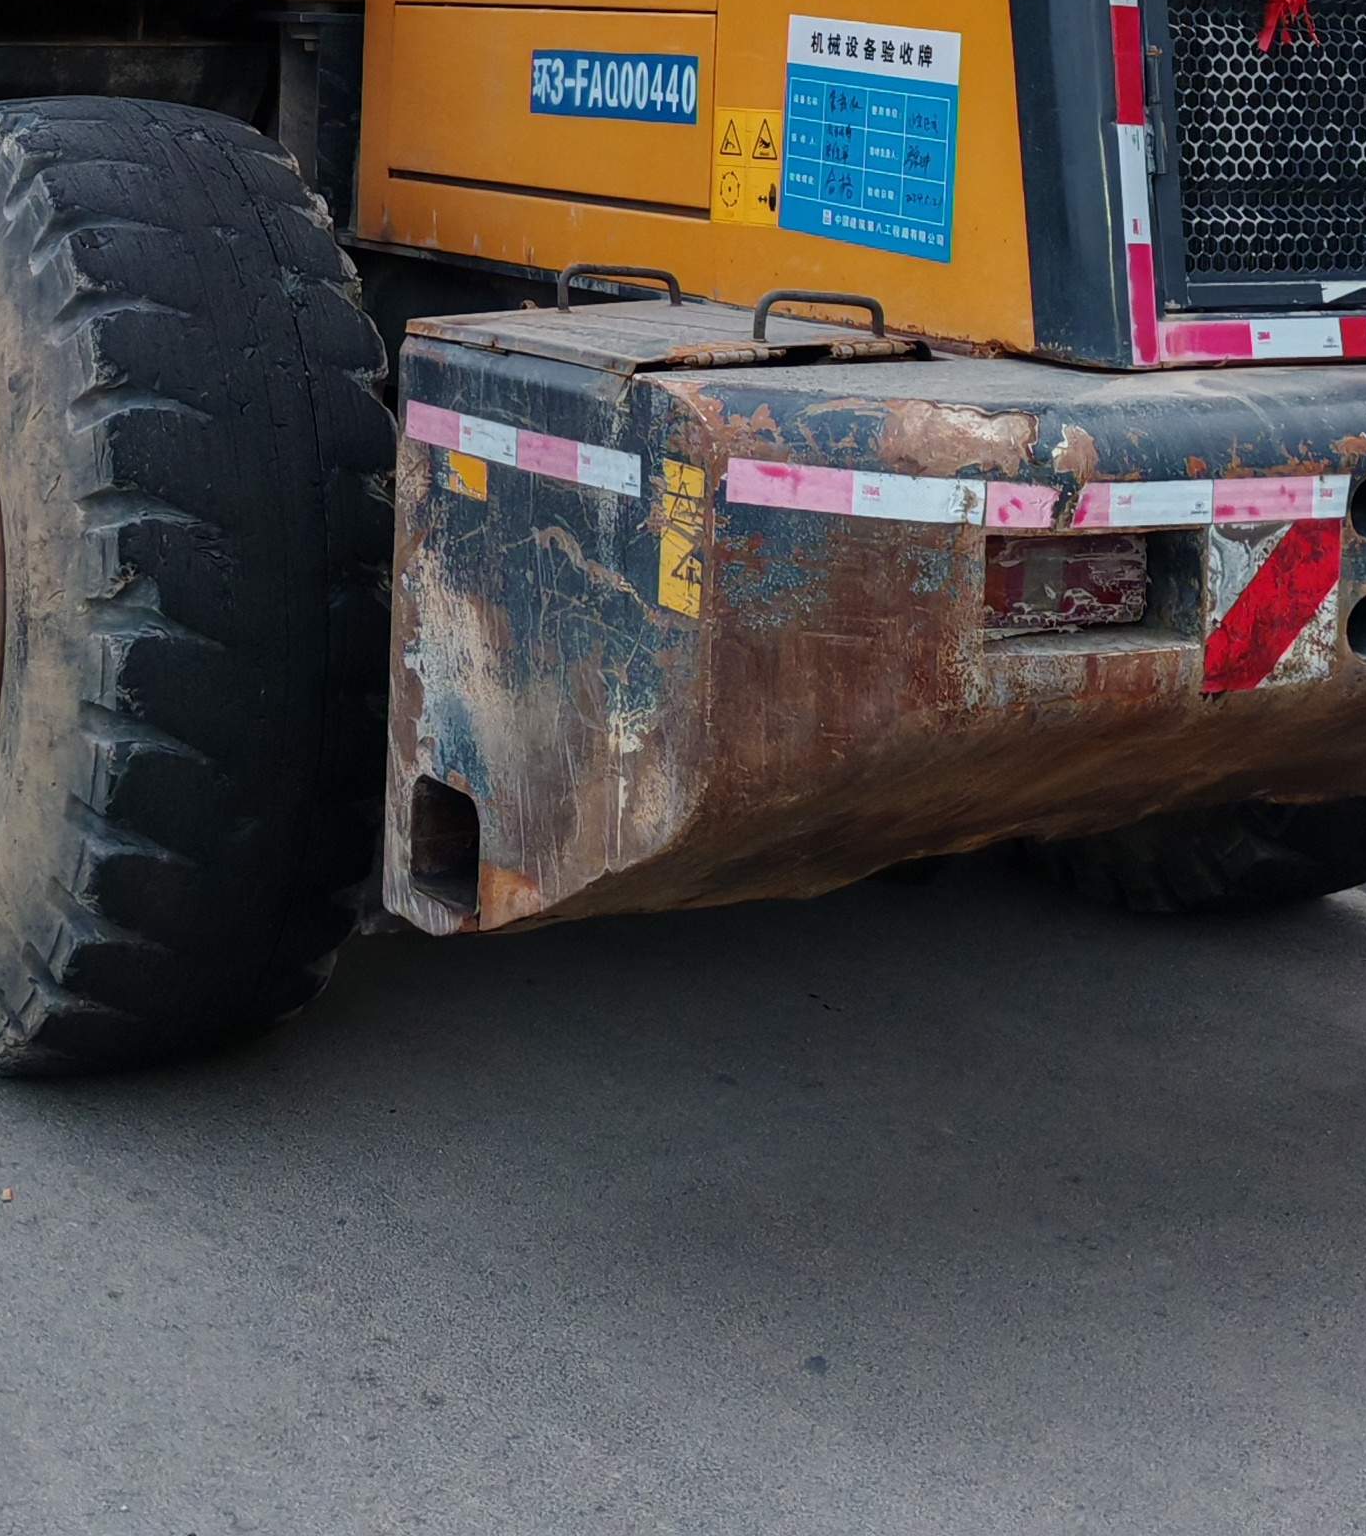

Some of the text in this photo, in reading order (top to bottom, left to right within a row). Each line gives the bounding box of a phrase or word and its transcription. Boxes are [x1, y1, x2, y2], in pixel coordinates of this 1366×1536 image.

[811, 31, 933, 68] 机械设备验收牌
[532, 57, 697, 114] 环3-FAQ00440
